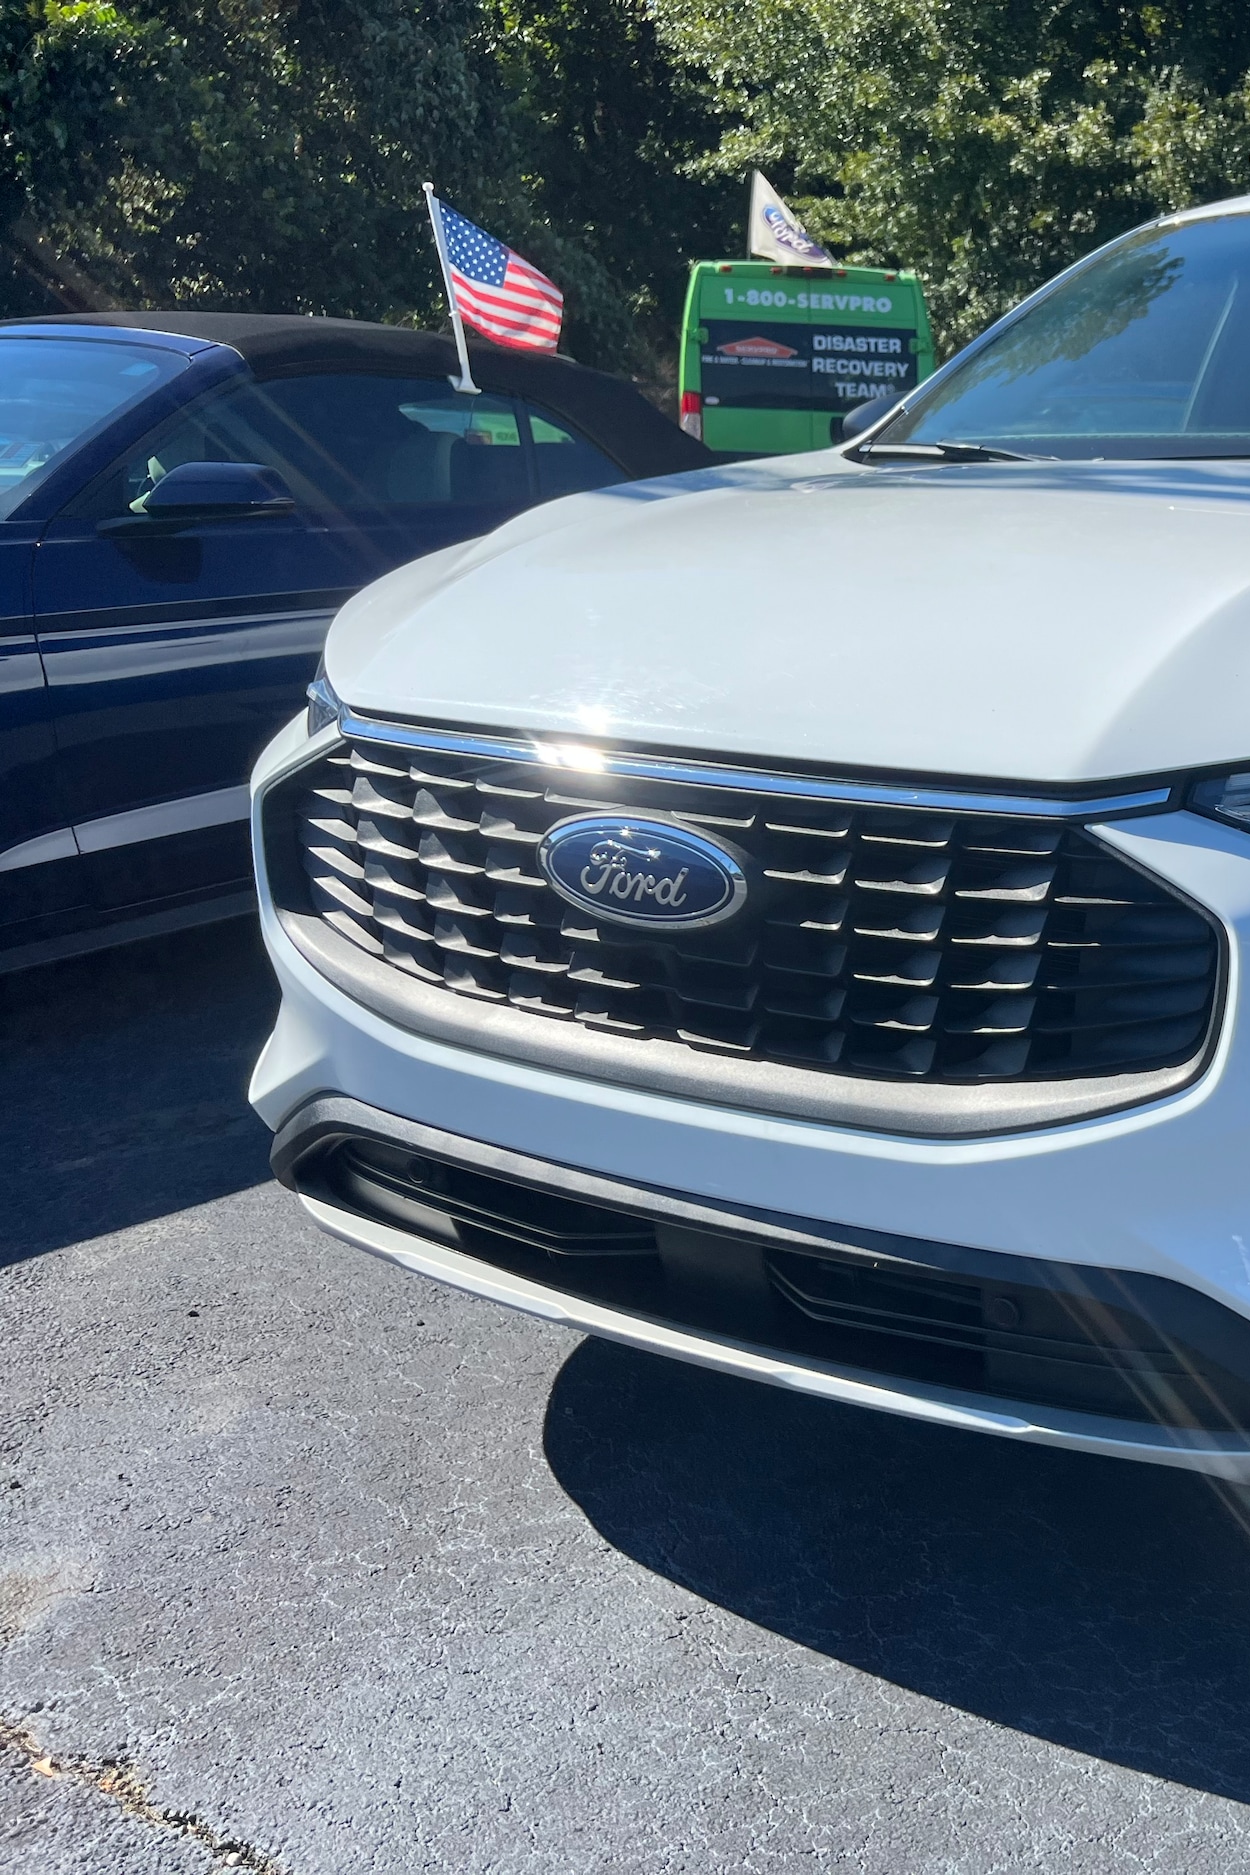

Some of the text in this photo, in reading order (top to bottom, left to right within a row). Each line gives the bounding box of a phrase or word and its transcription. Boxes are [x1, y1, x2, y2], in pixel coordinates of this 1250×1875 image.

[769, 211, 814, 253] Ford
[724, 288, 892, 313] 1-800-SERVPRO
[813, 335, 901, 354] DISASTER
[812, 357, 909, 378] RECOVERY
[580, 839, 690, 907] Ford
